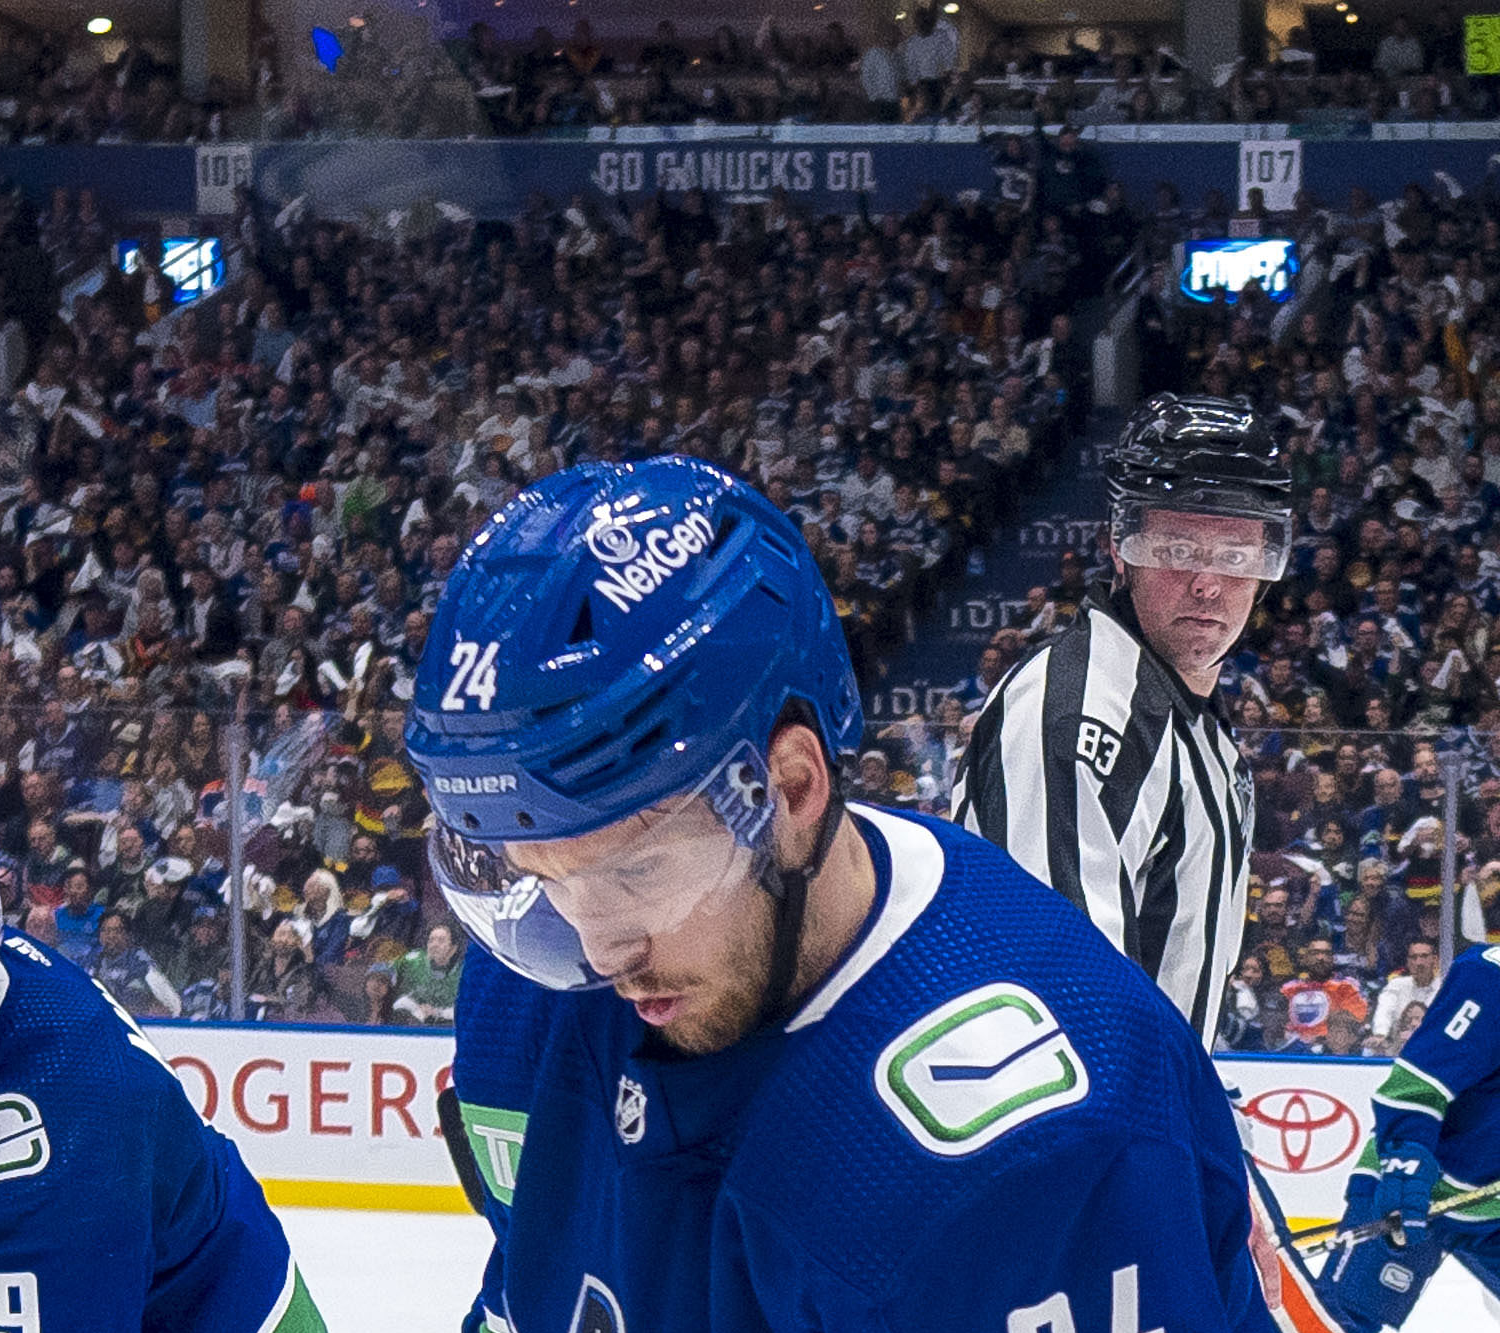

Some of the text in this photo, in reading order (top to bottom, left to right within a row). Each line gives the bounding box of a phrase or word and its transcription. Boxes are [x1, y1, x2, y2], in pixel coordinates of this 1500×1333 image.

[1247, 151, 1294, 182] 107
[594, 512, 714, 613] NexGen
[442, 642, 500, 711] 24
[1077, 721, 1121, 776] 83
[1445, 1000, 1482, 1040] 6
